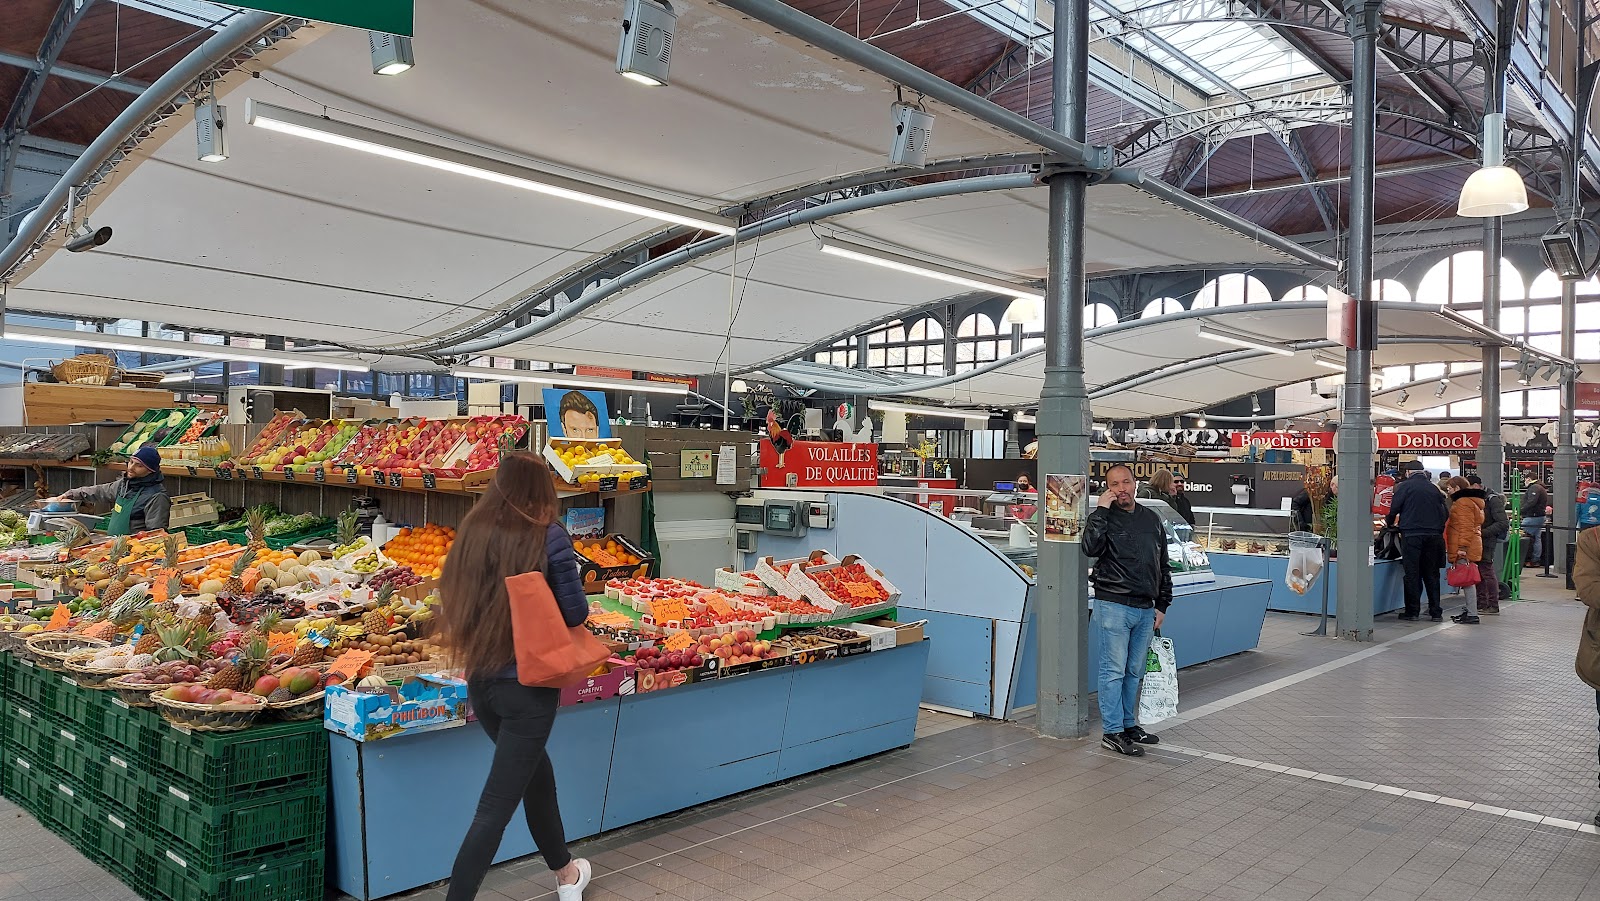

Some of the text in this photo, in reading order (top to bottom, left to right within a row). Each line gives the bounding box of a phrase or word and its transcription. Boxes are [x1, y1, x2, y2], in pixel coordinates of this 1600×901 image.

[1240, 433, 1474, 448] Boucherie Deblock
[808, 447, 871, 462] VOLAILLES
[805, 465, 876, 483] DE QUALITÉ
[1184, 481, 1213, 492] blanc
